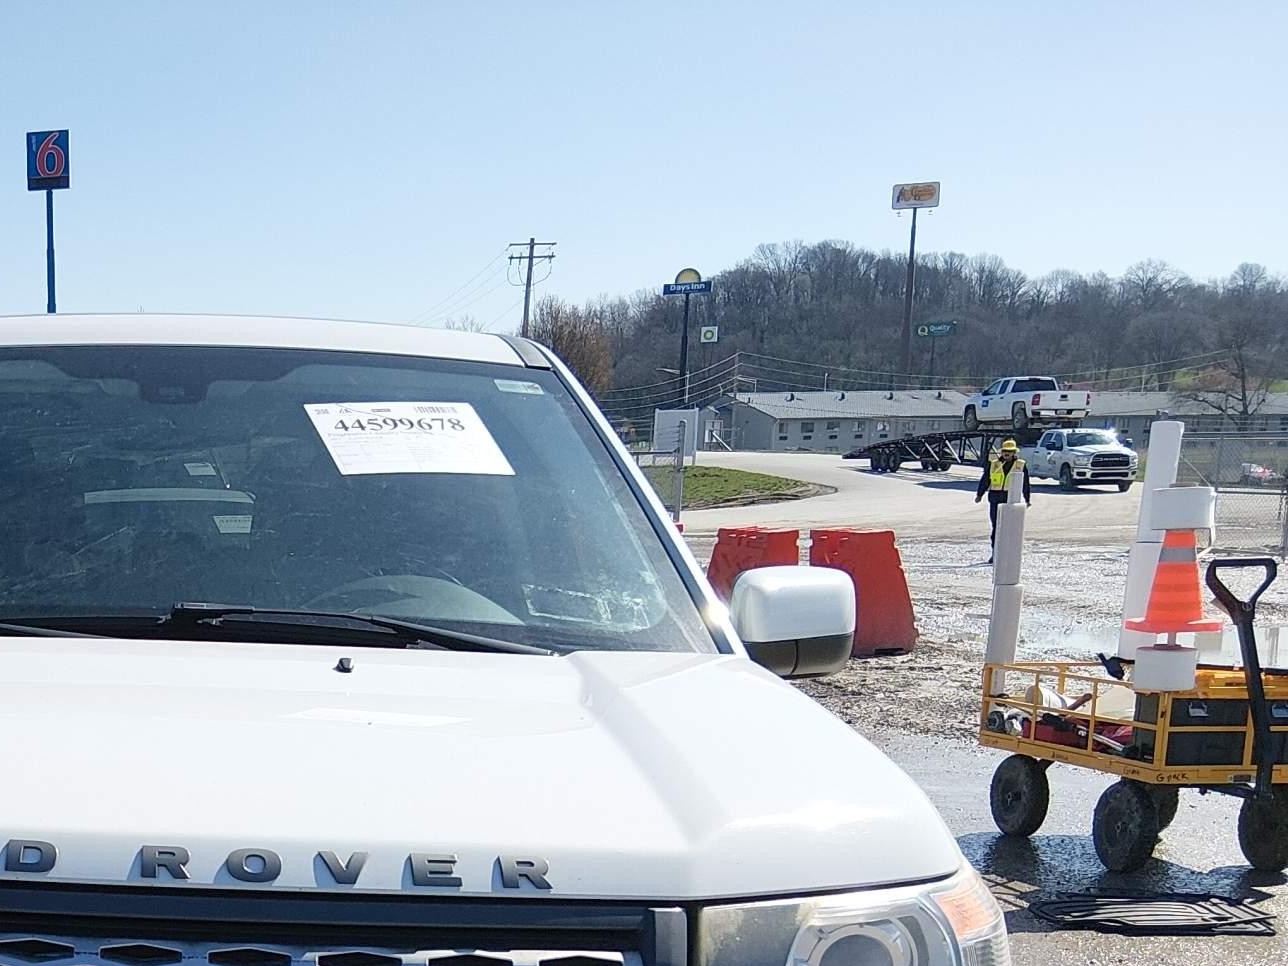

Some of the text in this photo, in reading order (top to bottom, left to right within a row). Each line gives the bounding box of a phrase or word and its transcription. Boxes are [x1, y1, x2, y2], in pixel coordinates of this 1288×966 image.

[36, 132, 65, 177] 6
[670, 284, 690, 293] Days
[333, 417, 465, 432] 44599678
[140, 845, 553, 890] ROVER
